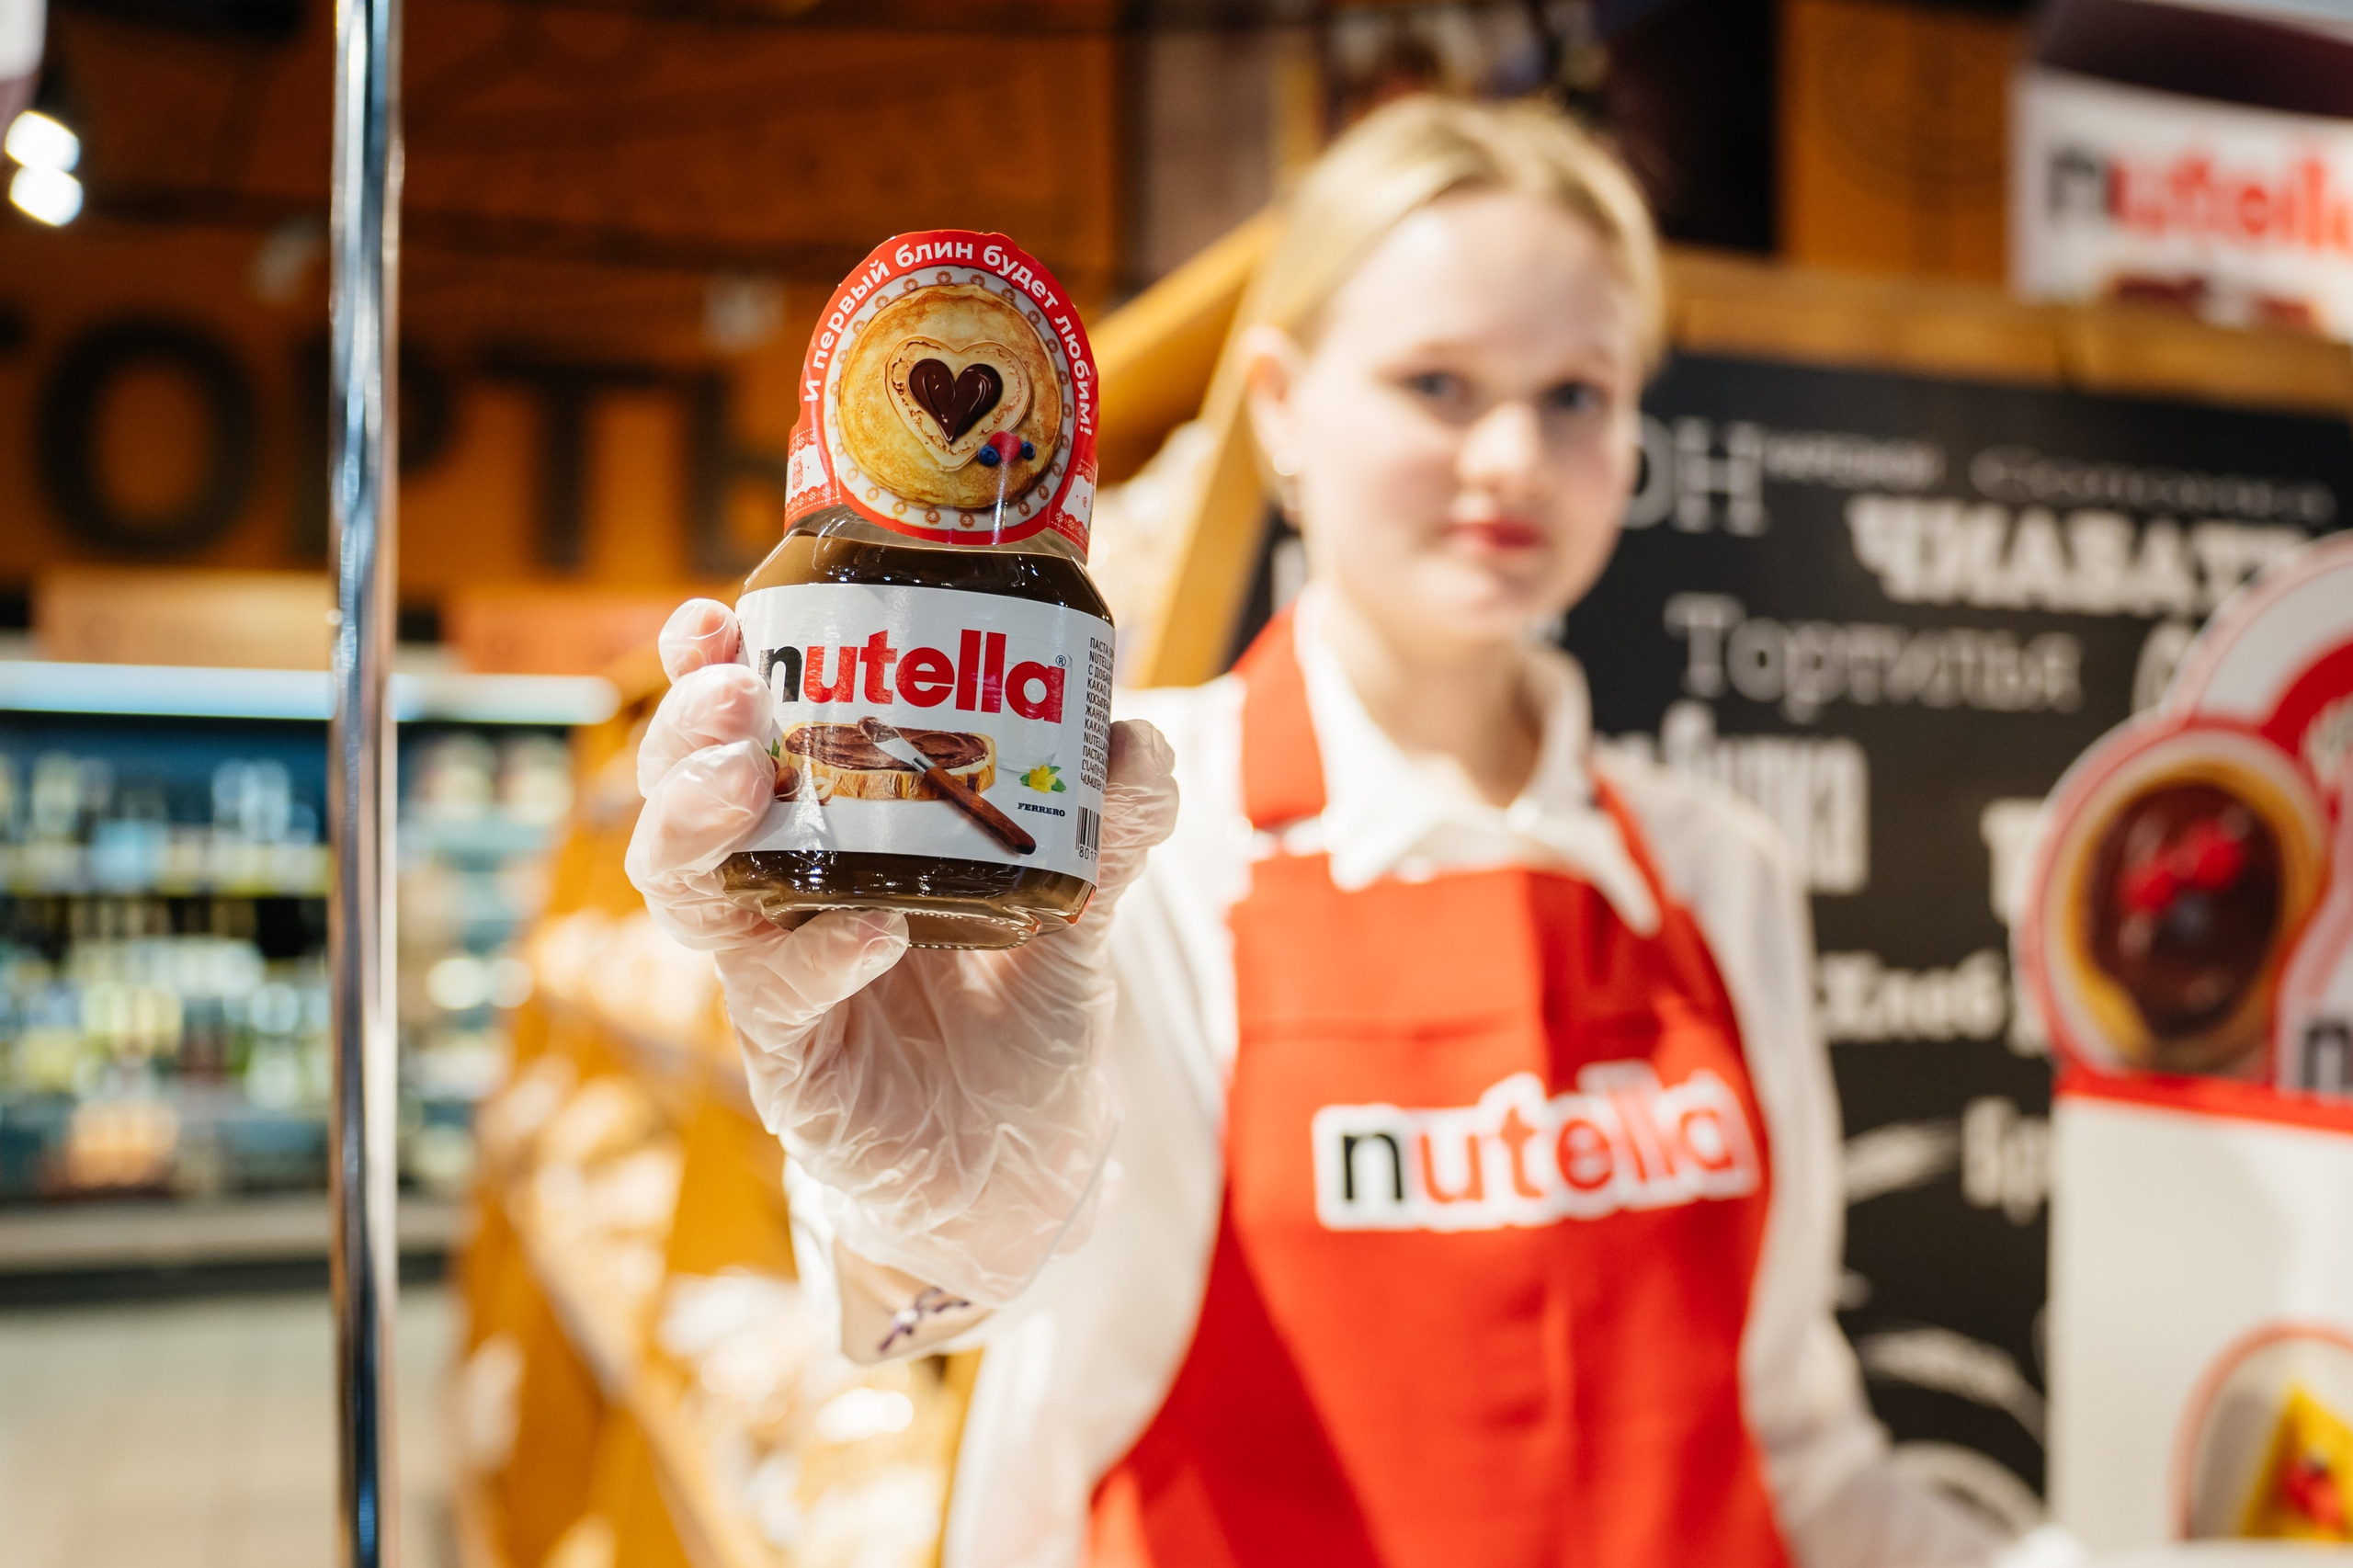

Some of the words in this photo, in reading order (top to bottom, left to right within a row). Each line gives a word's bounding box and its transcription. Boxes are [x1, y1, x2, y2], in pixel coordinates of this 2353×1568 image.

[804, 380, 821, 402] И
[813, 259, 891, 369] первый
[895, 241, 973, 267] блин
[983, 244, 1059, 309] будет
[1054, 314, 1092, 437] любим!
[0, 301, 789, 583] ОРТ
[1088, 664, 1094, 676] С
[1090, 637, 1108, 655] ПАСТА
[1017, 802, 1065, 817] FERRERO
[1337, 1083, 1751, 1206] nutella
